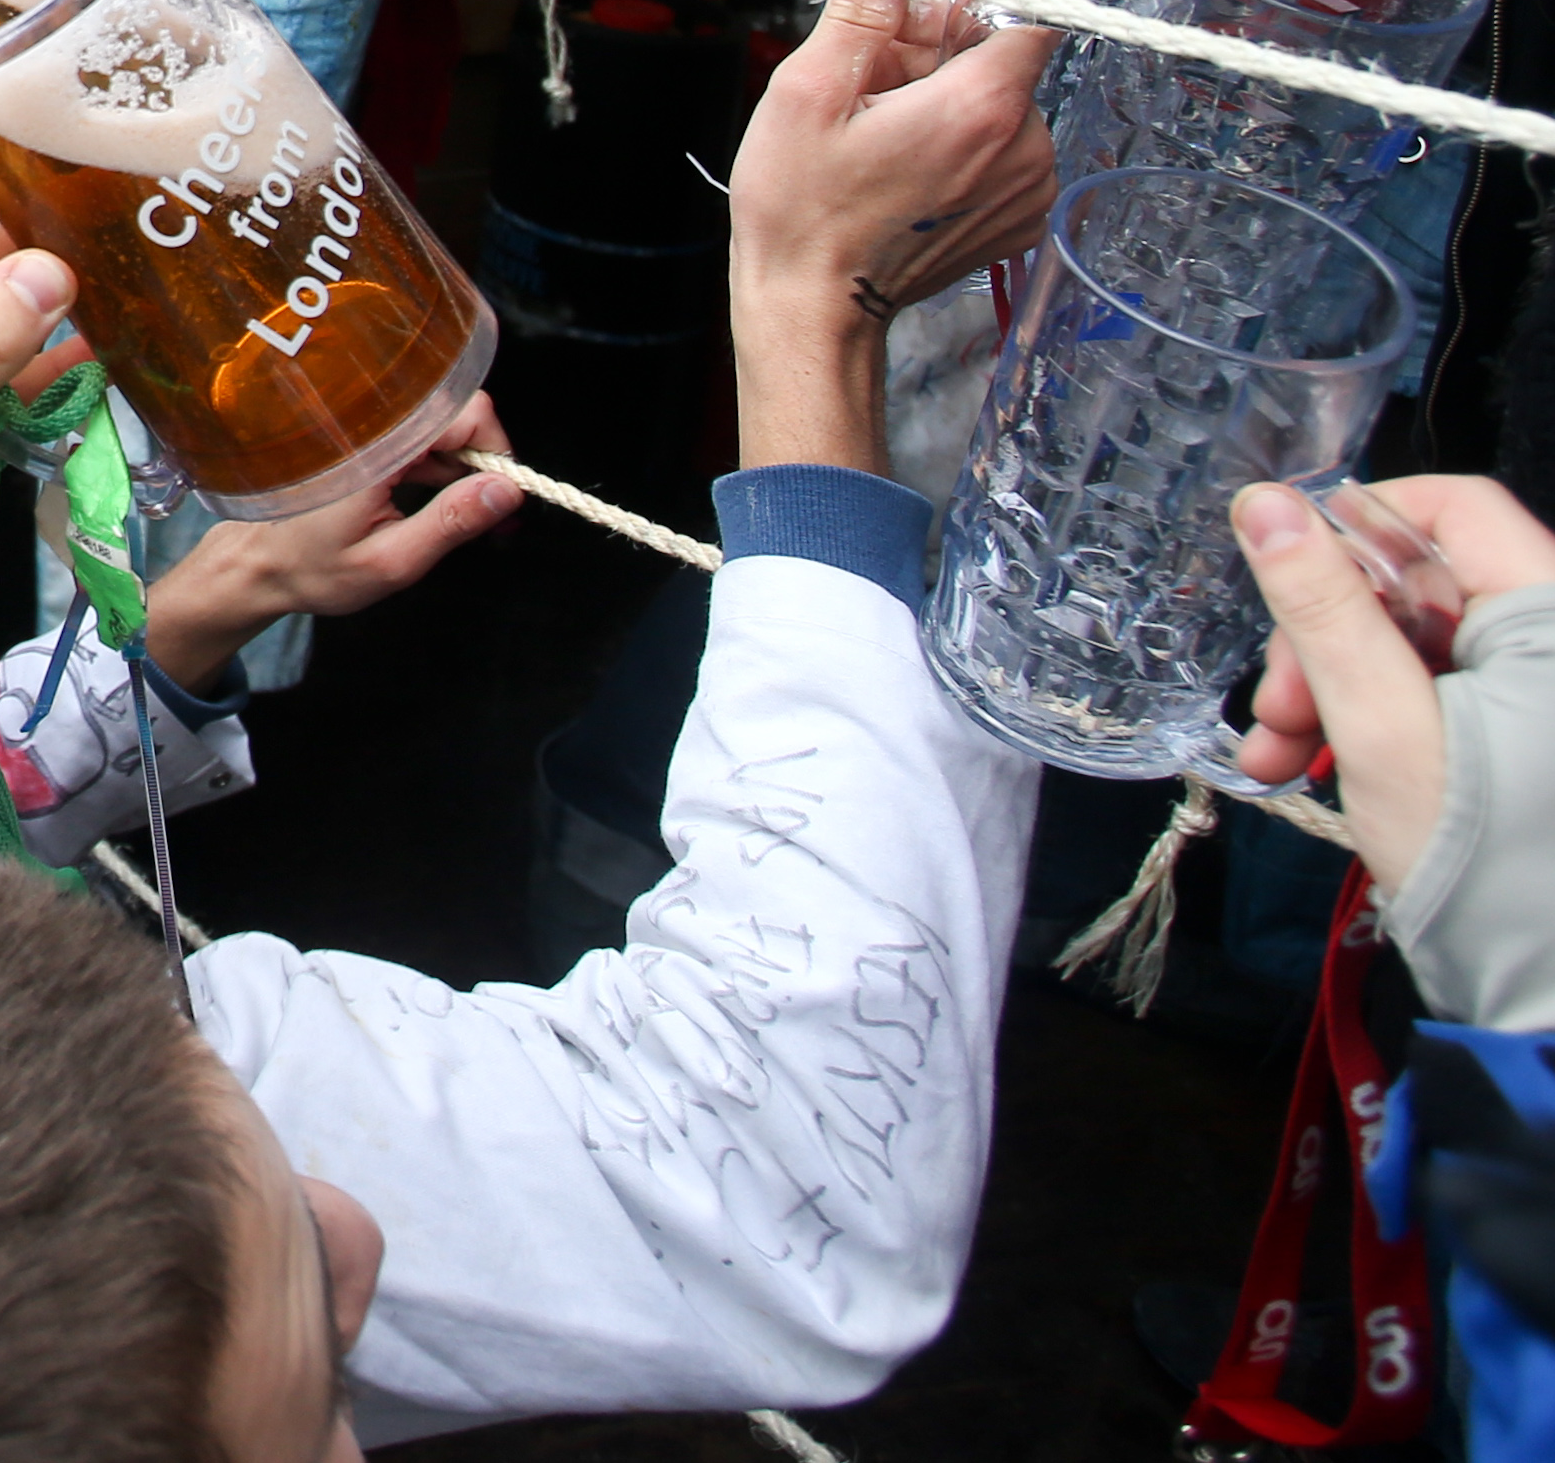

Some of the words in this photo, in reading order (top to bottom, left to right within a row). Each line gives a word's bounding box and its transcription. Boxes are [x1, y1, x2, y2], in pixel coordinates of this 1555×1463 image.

[137, 42, 265, 248] Cheer
[229, 120, 309, 248] from
[246, 122, 363, 357] London
